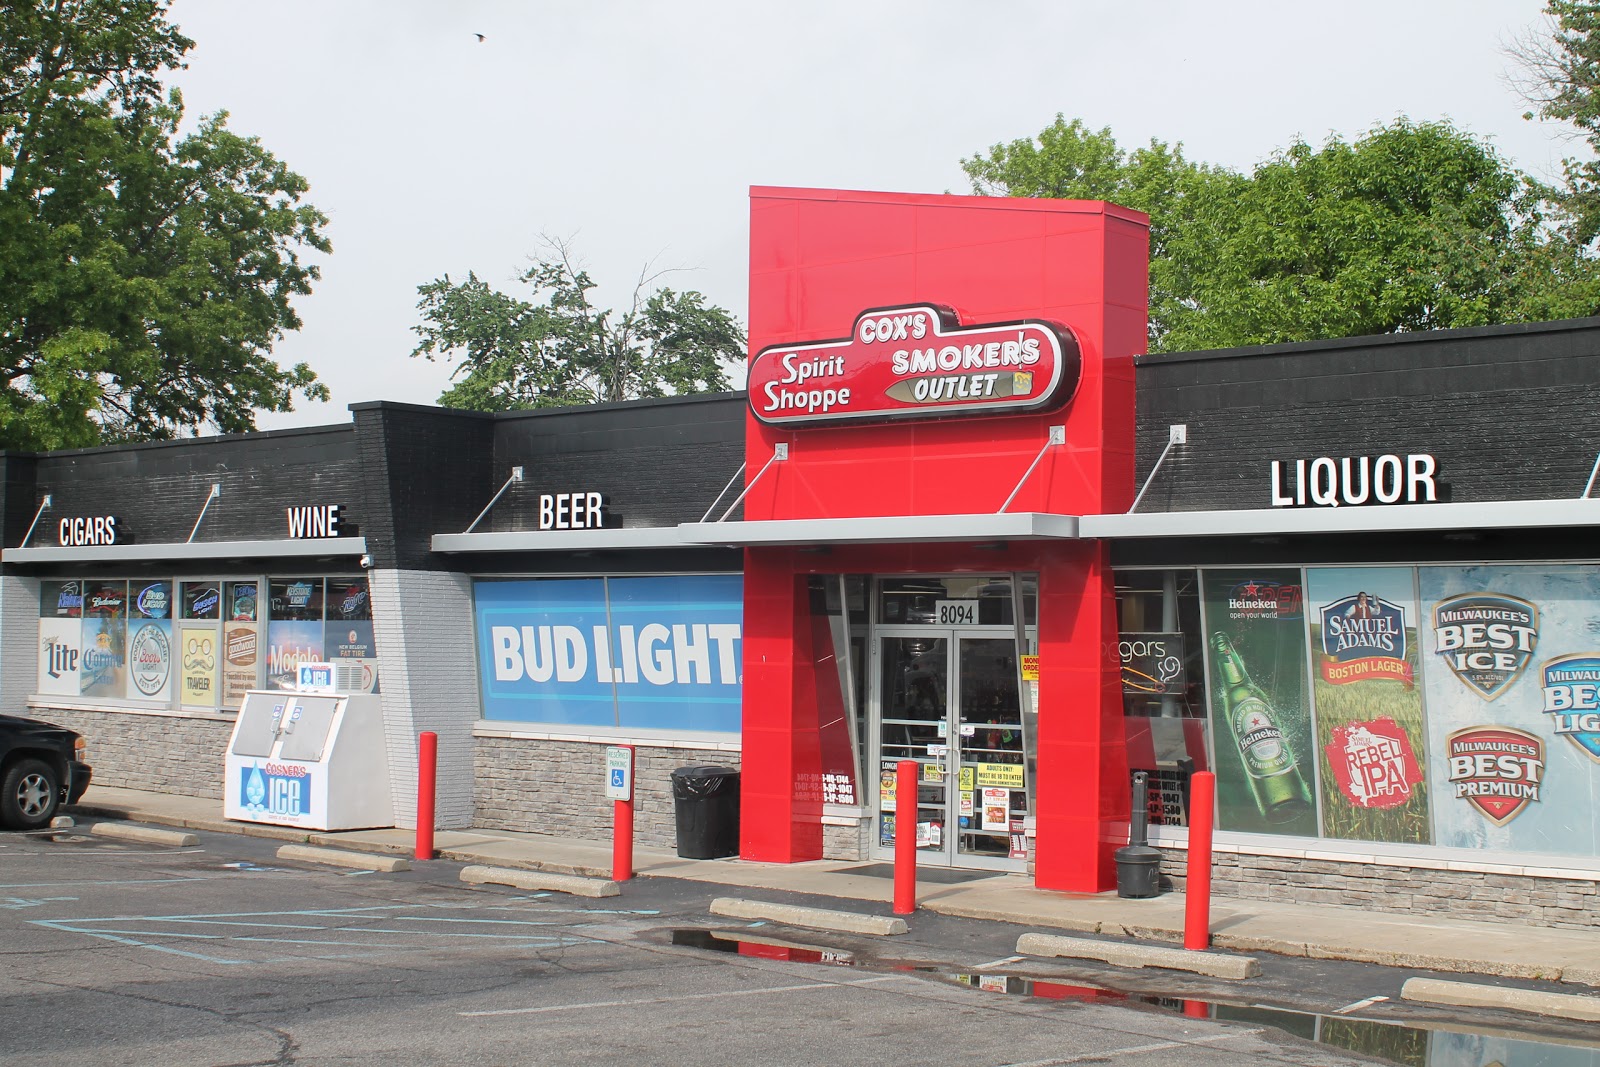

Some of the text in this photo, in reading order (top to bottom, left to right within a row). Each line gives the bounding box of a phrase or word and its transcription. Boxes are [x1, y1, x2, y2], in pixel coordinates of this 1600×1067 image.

[859, 313, 926, 344] COX'S
[891, 331, 1041, 375] SMOKER'S
[781, 353, 845, 384] Spirit
[763, 381, 850, 412] Shoppe
[914, 373, 998, 401] OUTLET
[1270, 454, 1437, 508] LIQUOR
[286, 504, 338, 538] WINE
[539, 492, 603, 530] BEER
[59, 515, 116, 546] CIGARS
[142, 599, 166, 609] LIGHT
[145, 590, 165, 600] BUD
[192, 595, 218, 612] BUSCH
[290, 596, 306, 604] LIGHT
[1228, 599, 1278, 609] Heineken
[197, 604, 213, 615] LIGHT
[940, 605, 974, 624] 8094
[1260, 611, 1278, 619] world
[1440, 610, 1530, 623] MILWAUKEE'S
[1329, 615, 1399, 636] SAMUEL
[228, 639, 256, 655] goodwood
[1335, 633, 1394, 653] ADAMS
[1434, 623, 1537, 654] BEST
[47, 642, 79, 679] Lite
[139, 648, 161, 663] Coors
[492, 623, 741, 685] BUD LIGHT
[1455, 651, 1518, 672] ICE
[313, 671, 327, 686] ICE
[1328, 660, 1404, 679] BOSTON LAGER
[187, 676, 211, 691] TRAVELER
[1239, 729, 1284, 750] Heineken
[1453, 742, 1537, 756] MILWAUKEE'S
[1249, 757, 1274, 769] PREMIUM
[1346, 740, 1404, 769] REBEL
[1359, 760, 1409, 797] IPA
[1449, 754, 1545, 783] BEST
[268, 777, 301, 816] ICE
[1455, 782, 1540, 802] PREMIUM
